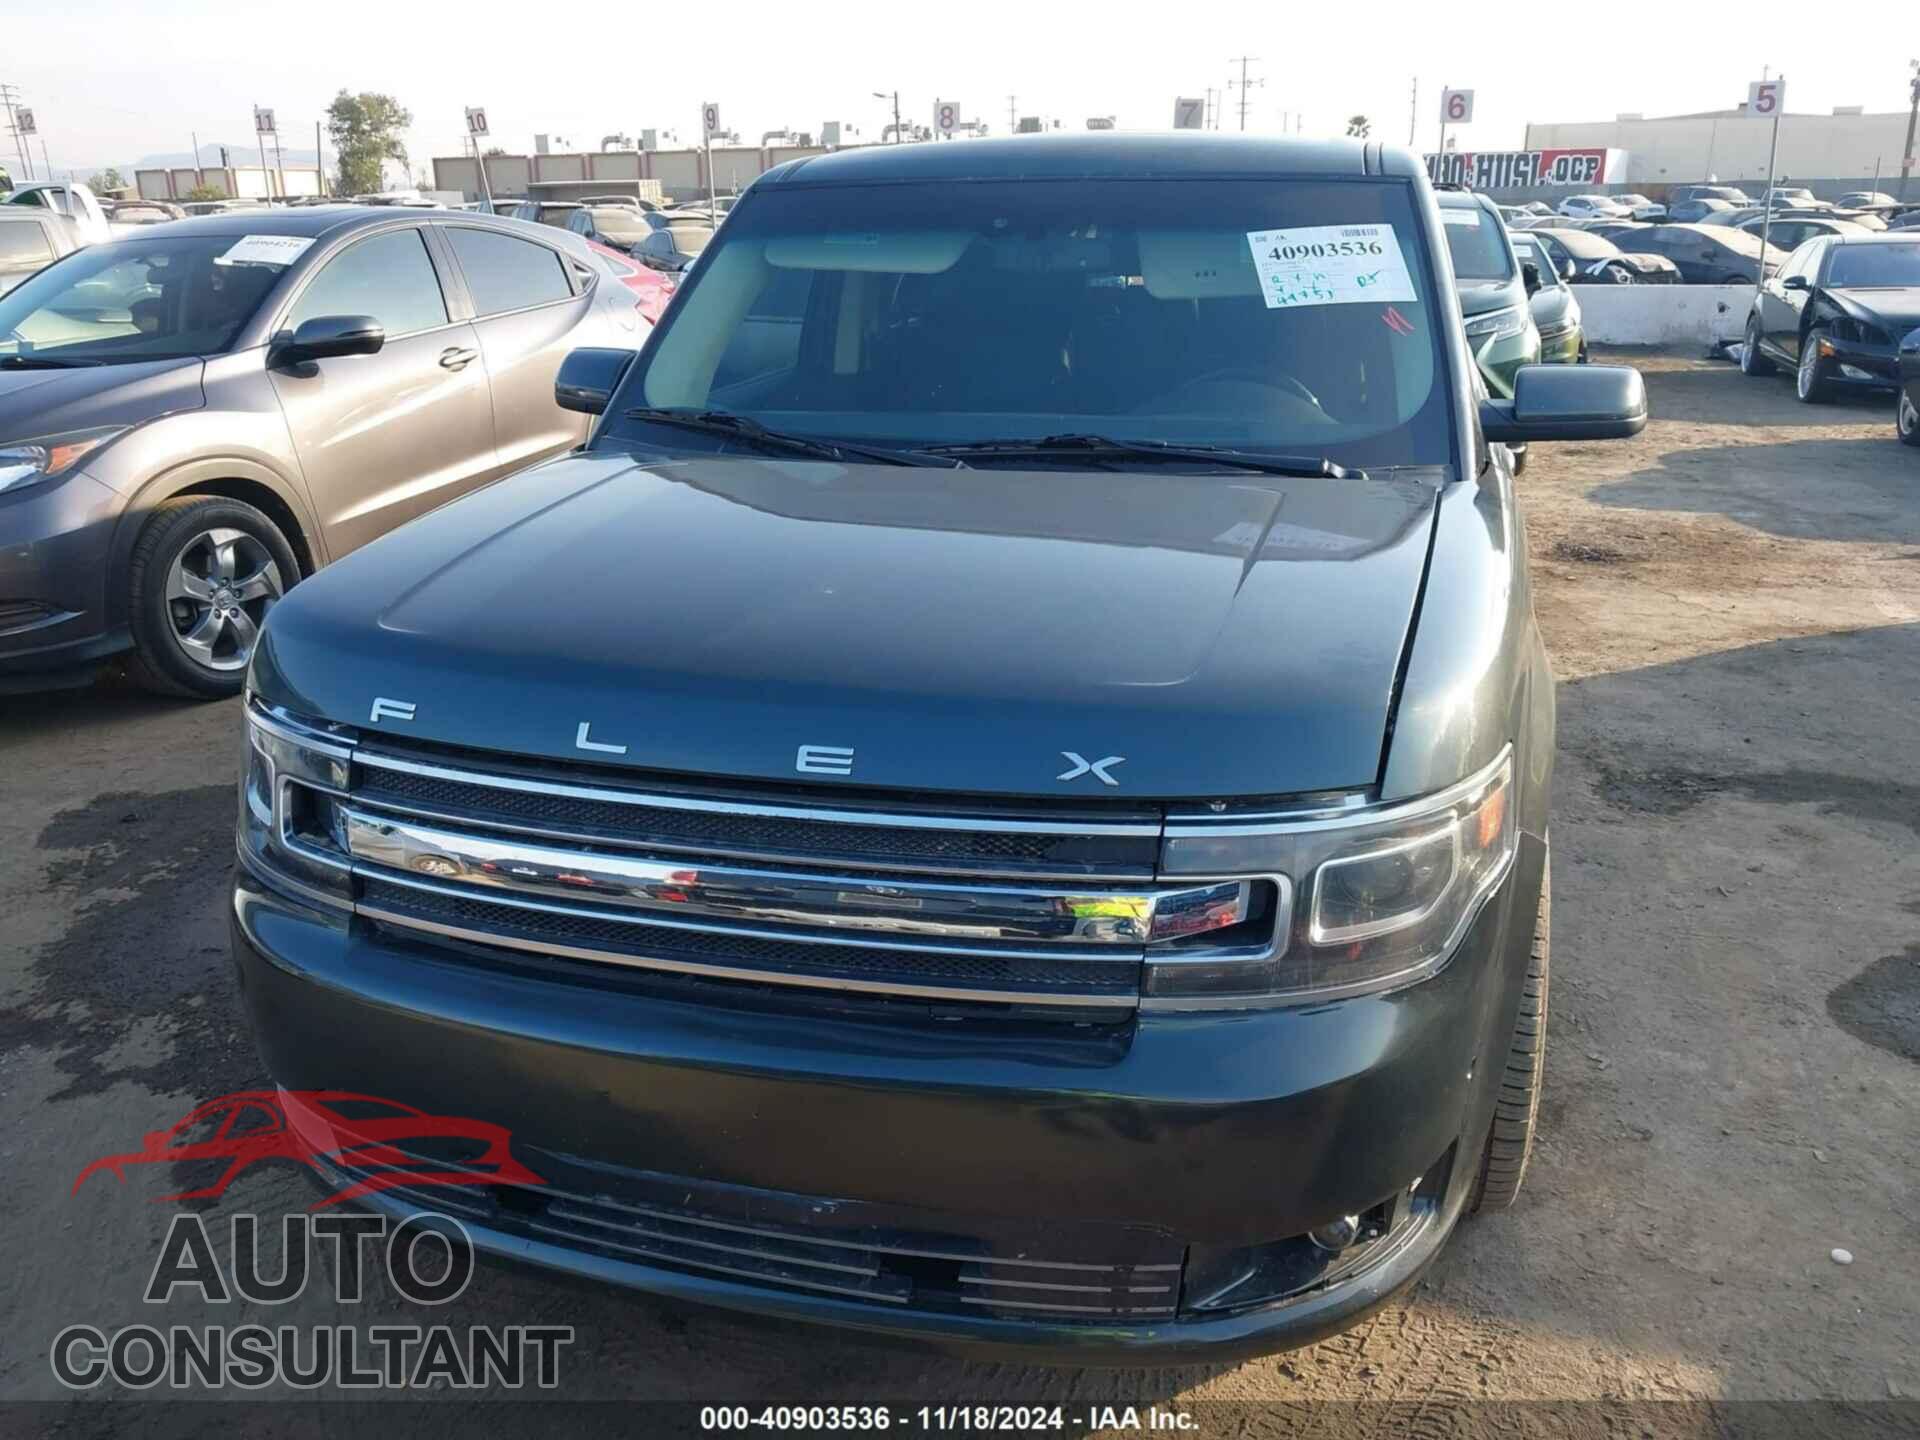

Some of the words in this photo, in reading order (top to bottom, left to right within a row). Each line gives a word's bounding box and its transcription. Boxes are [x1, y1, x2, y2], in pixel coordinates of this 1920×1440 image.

[1447, 93, 1466, 119] 6
[1755, 84, 1777, 112] 5
[17, 112, 36, 131] 12
[255, 113, 275, 131] 11
[466, 112, 488, 132] 10
[705, 107, 716, 130] 9
[939, 106, 954, 129] 8
[1181, 102, 1200, 126] 7
[1268, 240, 1383, 260] 40903536
